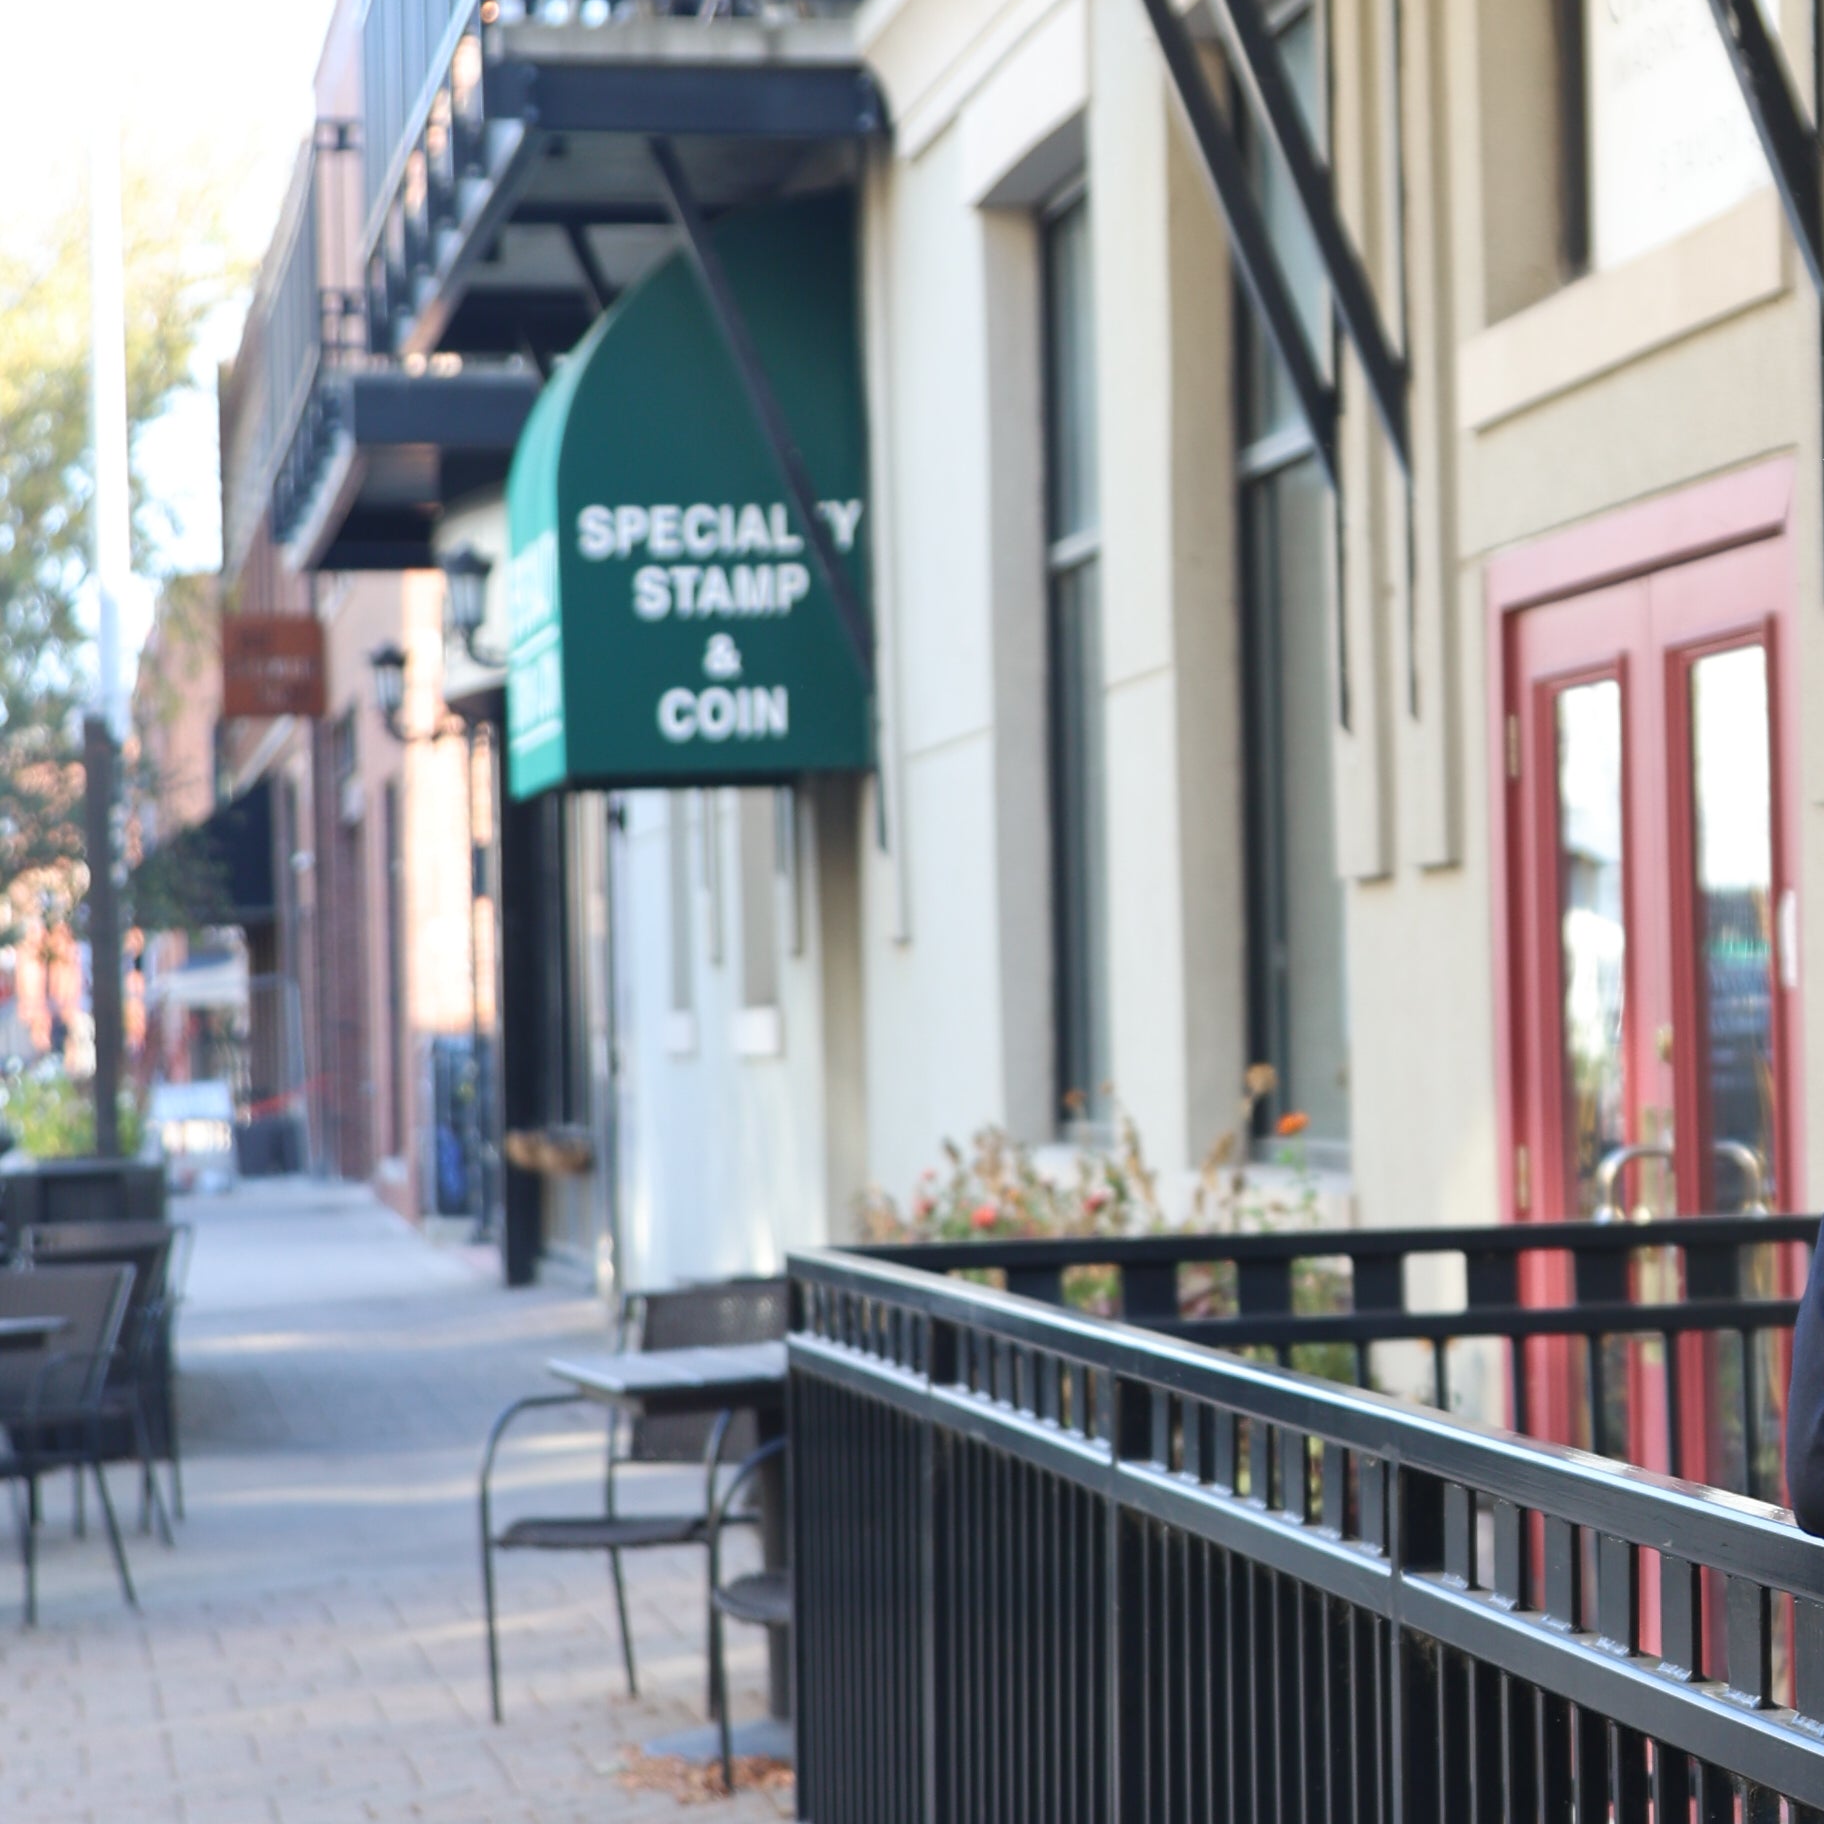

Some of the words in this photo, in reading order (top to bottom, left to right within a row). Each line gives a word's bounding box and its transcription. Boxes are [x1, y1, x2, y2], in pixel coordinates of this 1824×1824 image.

[577, 498, 863, 560] SPECIALY
[633, 562, 811, 620] STAMP
[703, 632, 742, 678] &
[657, 684, 789, 743] COIN
